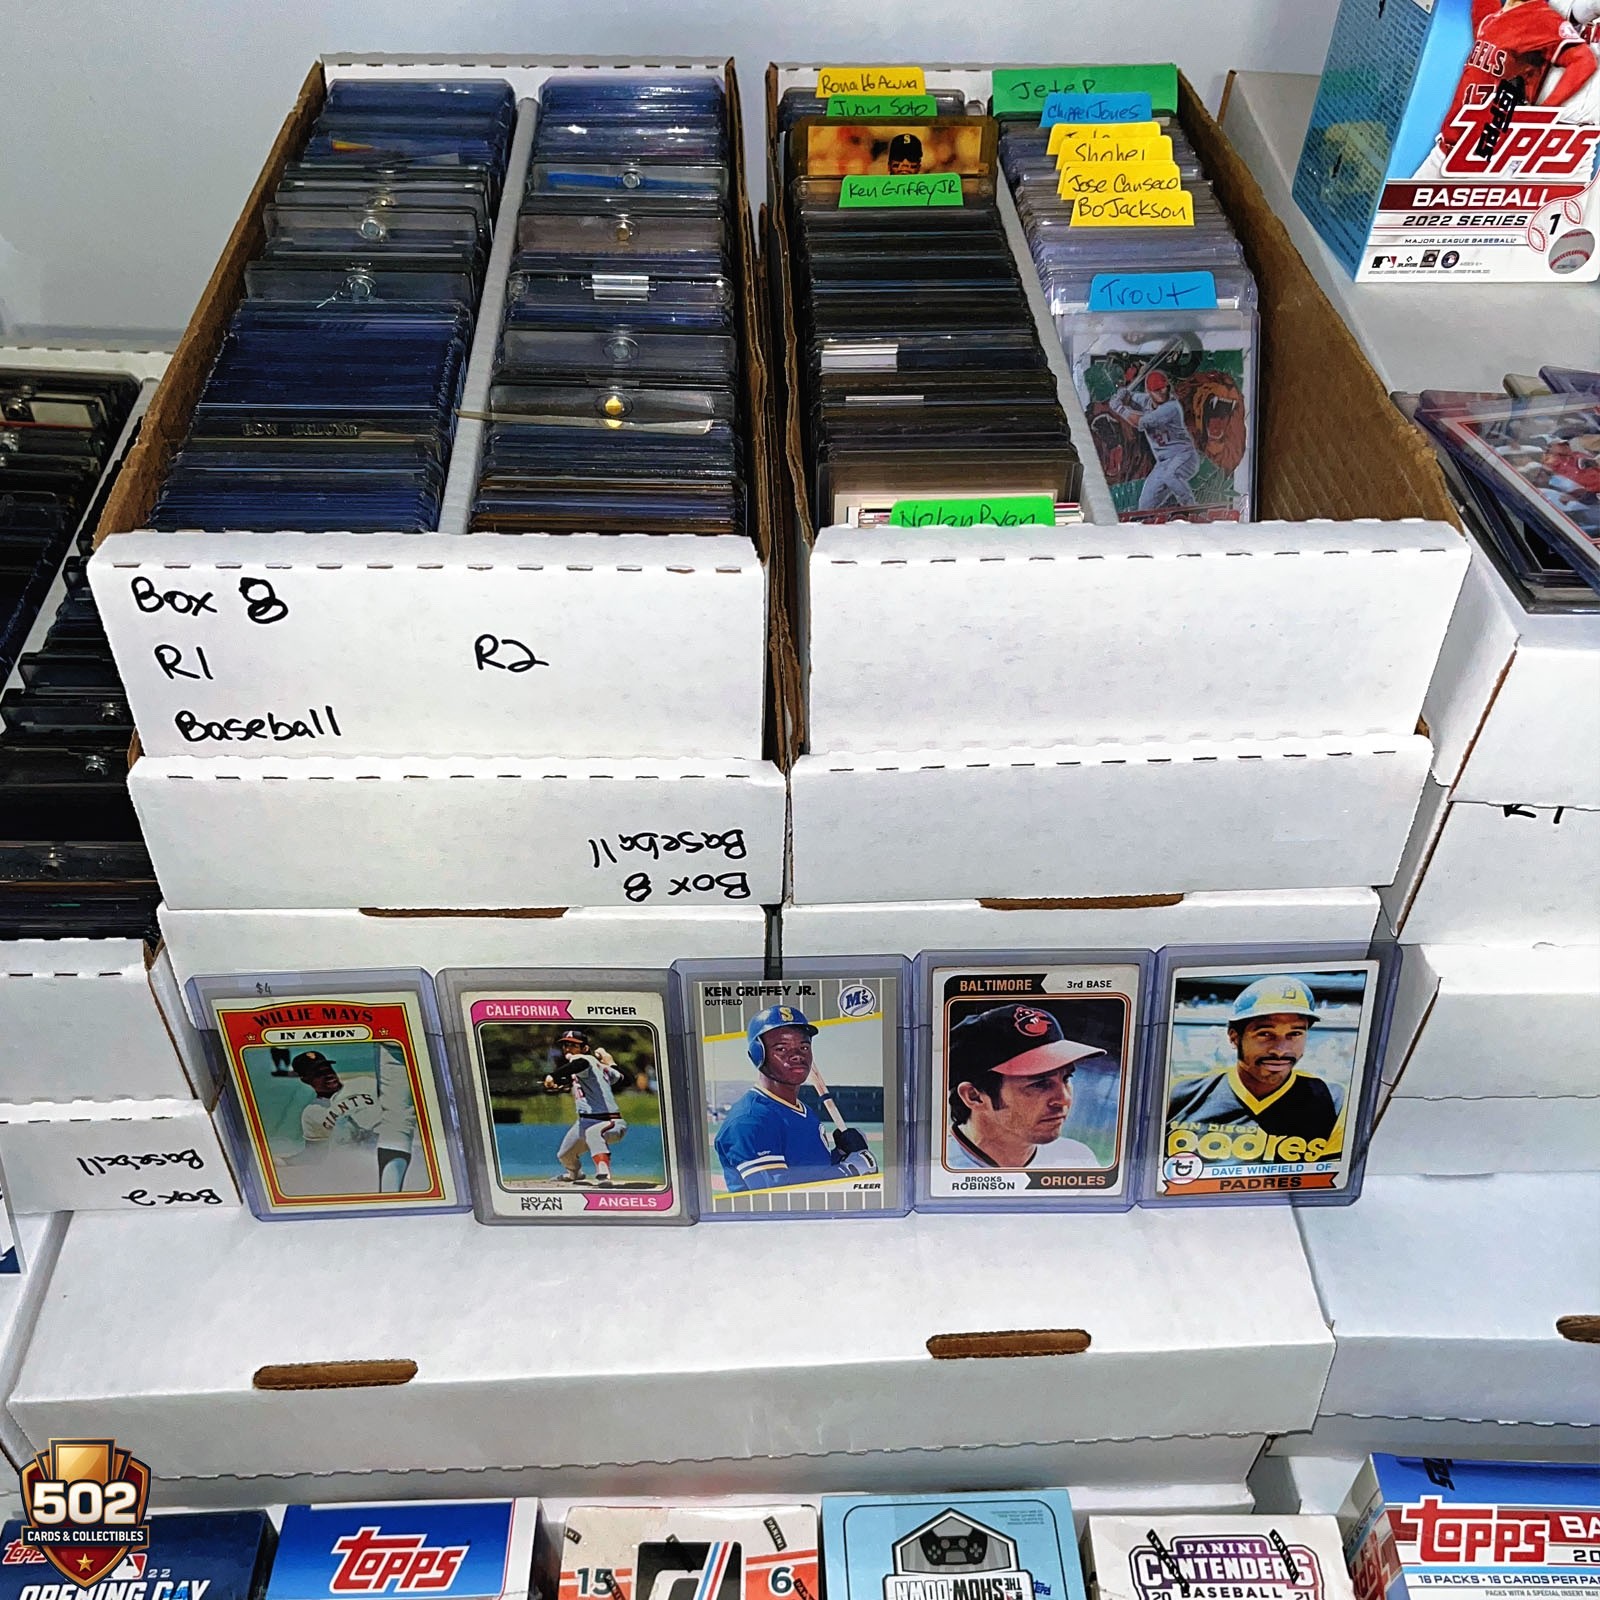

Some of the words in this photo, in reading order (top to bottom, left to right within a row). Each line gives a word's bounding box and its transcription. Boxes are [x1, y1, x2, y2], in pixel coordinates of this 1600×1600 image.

[890, 98, 928, 116] Soto
[1068, 174, 1107, 193] Jose
[1113, 173, 1178, 193] Canseco
[848, 183, 877, 198] Ken
[881, 181, 937, 206] Griffey
[1411, 187, 1549, 207] BASEBALL
[1078, 197, 1104, 217] Bo
[1104, 197, 1187, 220] Jackson
[1402, 215, 1452, 227] 2022
[1456, 215, 1528, 226] SERIES
[1549, 213, 1562, 236] 1
[1100, 278, 1201, 306] Trout
[131, 576, 218, 616] Box
[239, 576, 289, 624] 8
[474, 633, 550, 673] R2
[174, 705, 342, 742] Baseball
[588, 829, 748, 869] Baseball
[623, 872, 652, 902] 8
[667, 872, 752, 899] Box
[256, 982, 272, 995] $4
[704, 986, 732, 997] KEN
[735, 986, 792, 997] GRIFFEY
[795, 985, 816, 997] JR.
[959, 979, 1033, 992] BALTIMORE
[1066, 980, 1083, 989] 3rd
[1086, 980, 1113, 989] BASE
[253, 1008, 315, 1028] WILLIE
[322, 1007, 374, 1023] MAYS
[486, 1004, 560, 1017] CALIFORNIA
[587, 1006, 637, 1016] PITCHER
[779, 1007, 794, 1022] S
[280, 1031, 296, 1040] IN
[302, 1029, 355, 1040] ACTION
[322, 1093, 375, 1131] GIANTS
[1212, 1167, 1242, 1176] DAVE
[1247, 1164, 1304, 1174] WINFIELD
[1316, 1163, 1332, 1172] OF
[952, 1182, 1015, 1190] ROBINSON
[1040, 1175, 1106, 1186] ORIOLES
[1219, 1176, 1302, 1190] PADRES
[521, 1203, 562, 1211] RYAN
[598, 1197, 657, 1207] ANGELS
[766, 1519, 784, 1548] PANINI
[1181, 1542, 1262, 1555] PANINI
[577, 1567, 612, 1595] 15
[771, 1566, 792, 1594] 6
[1004, 1577, 1022, 1590] THE
[1434, 1575, 1480, 1584] PACKS
[1503, 1576, 1549, 1584] CARDS
[1552, 1576, 1578, 1585] PER
[1182, 1586, 1283, 1598] BASEBALL
